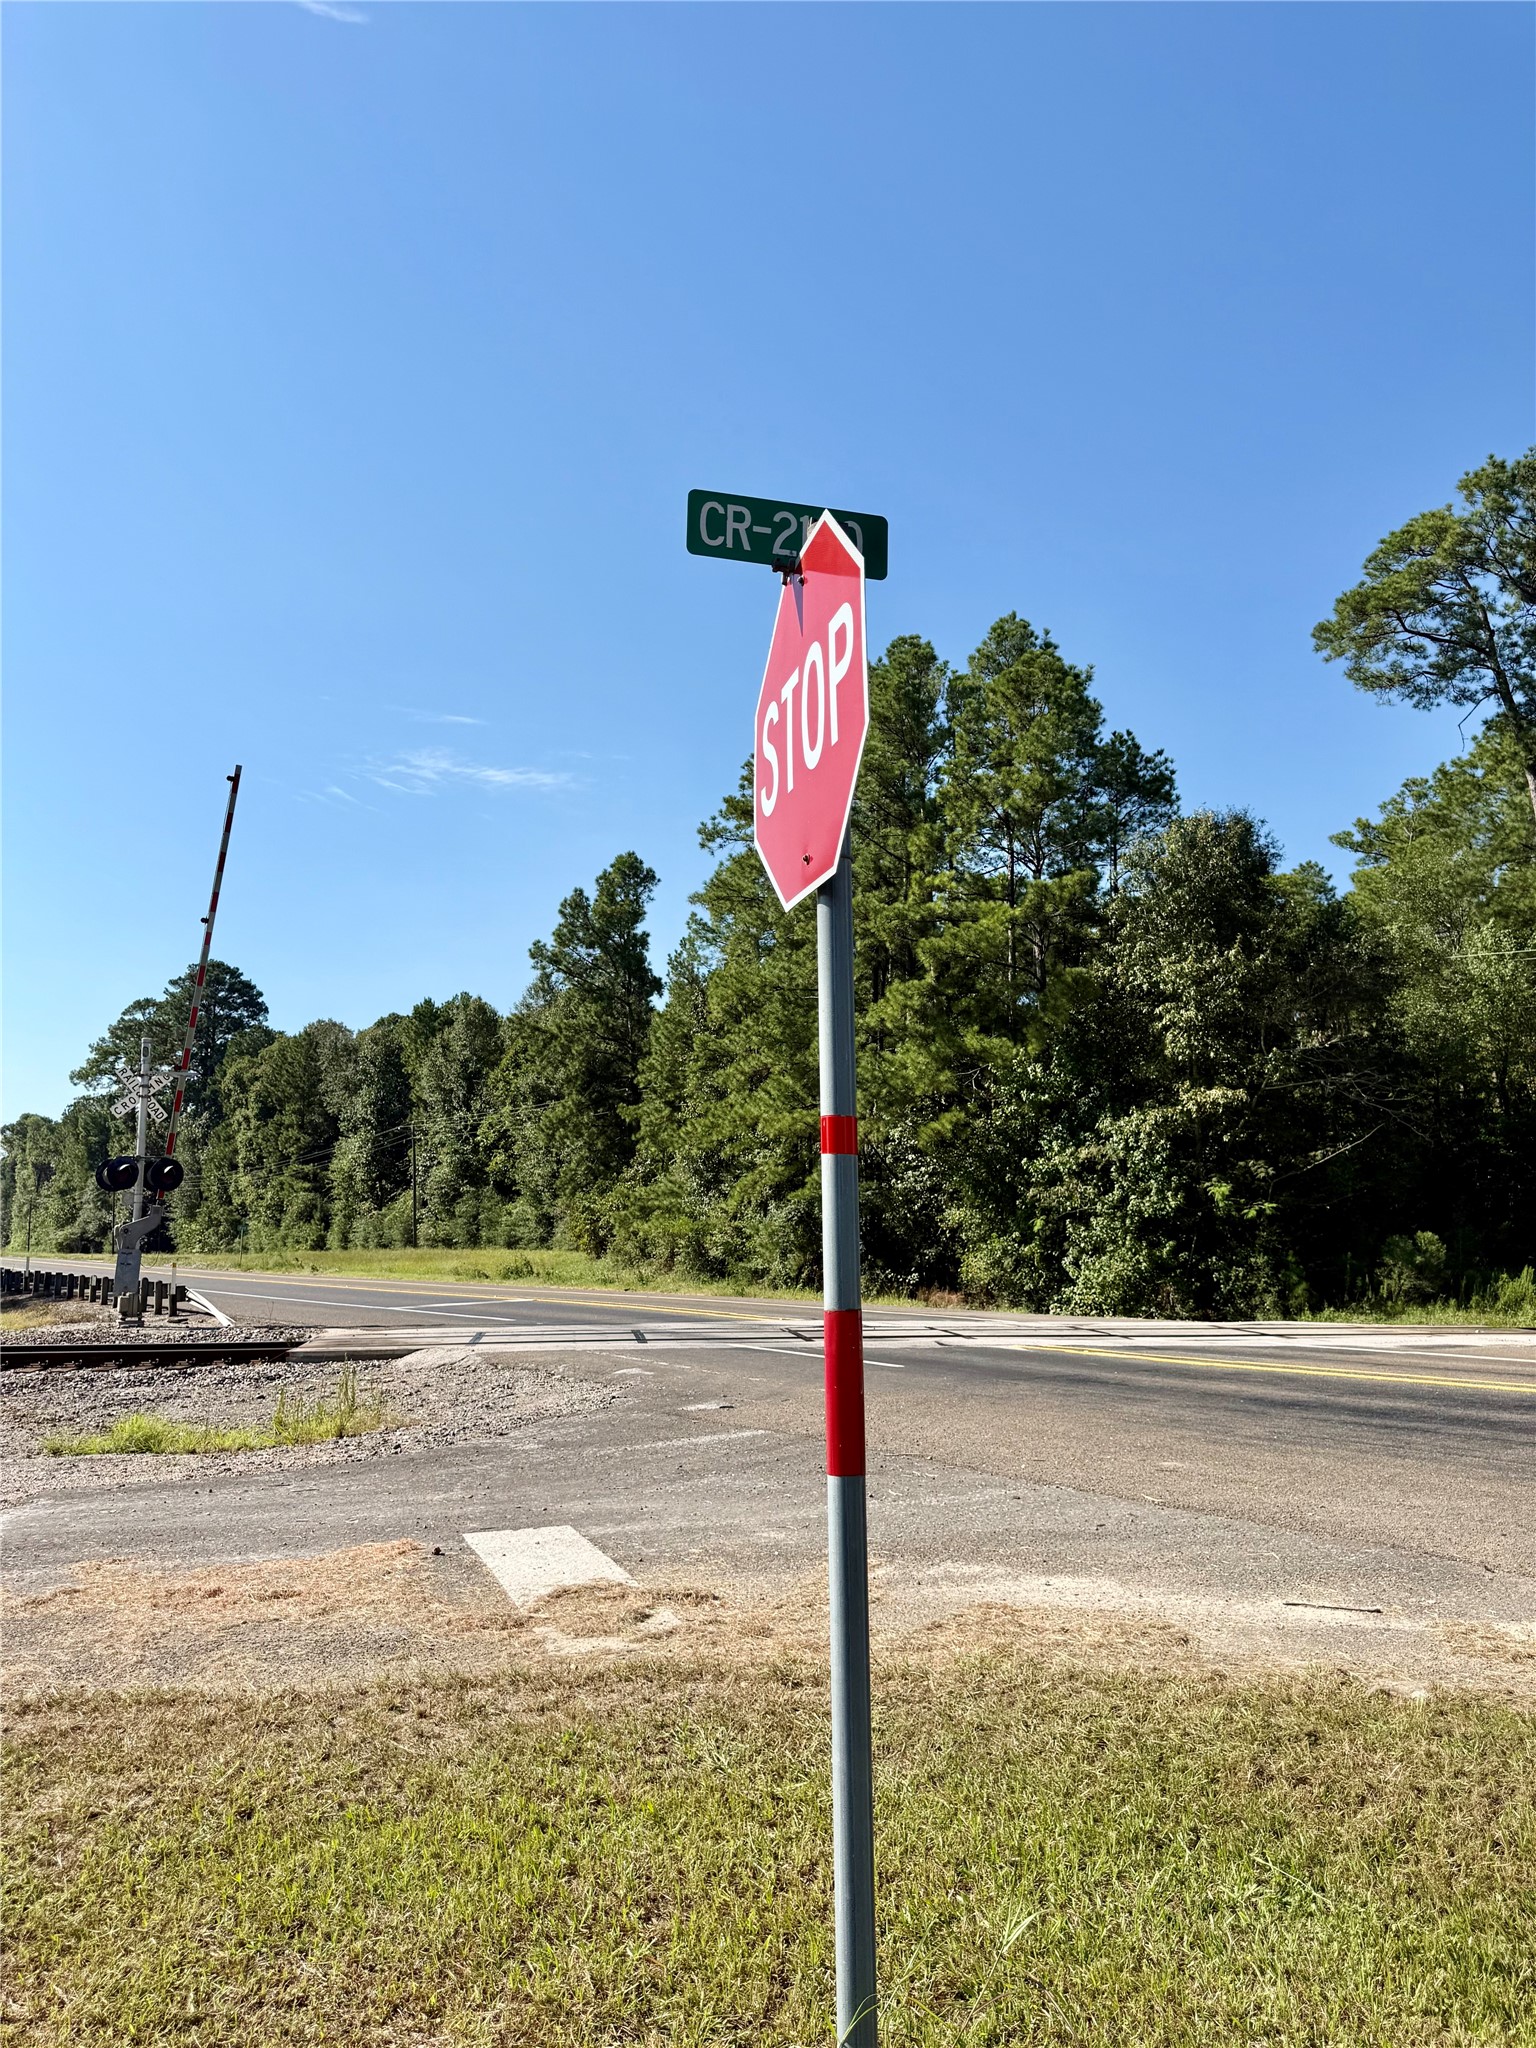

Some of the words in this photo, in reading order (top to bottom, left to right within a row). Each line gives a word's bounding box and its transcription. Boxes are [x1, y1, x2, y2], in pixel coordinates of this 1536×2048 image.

[700, 501, 863, 557] CR-21
[761, 602, 854, 818] STOP
[113, 1073, 171, 1115] CROING
